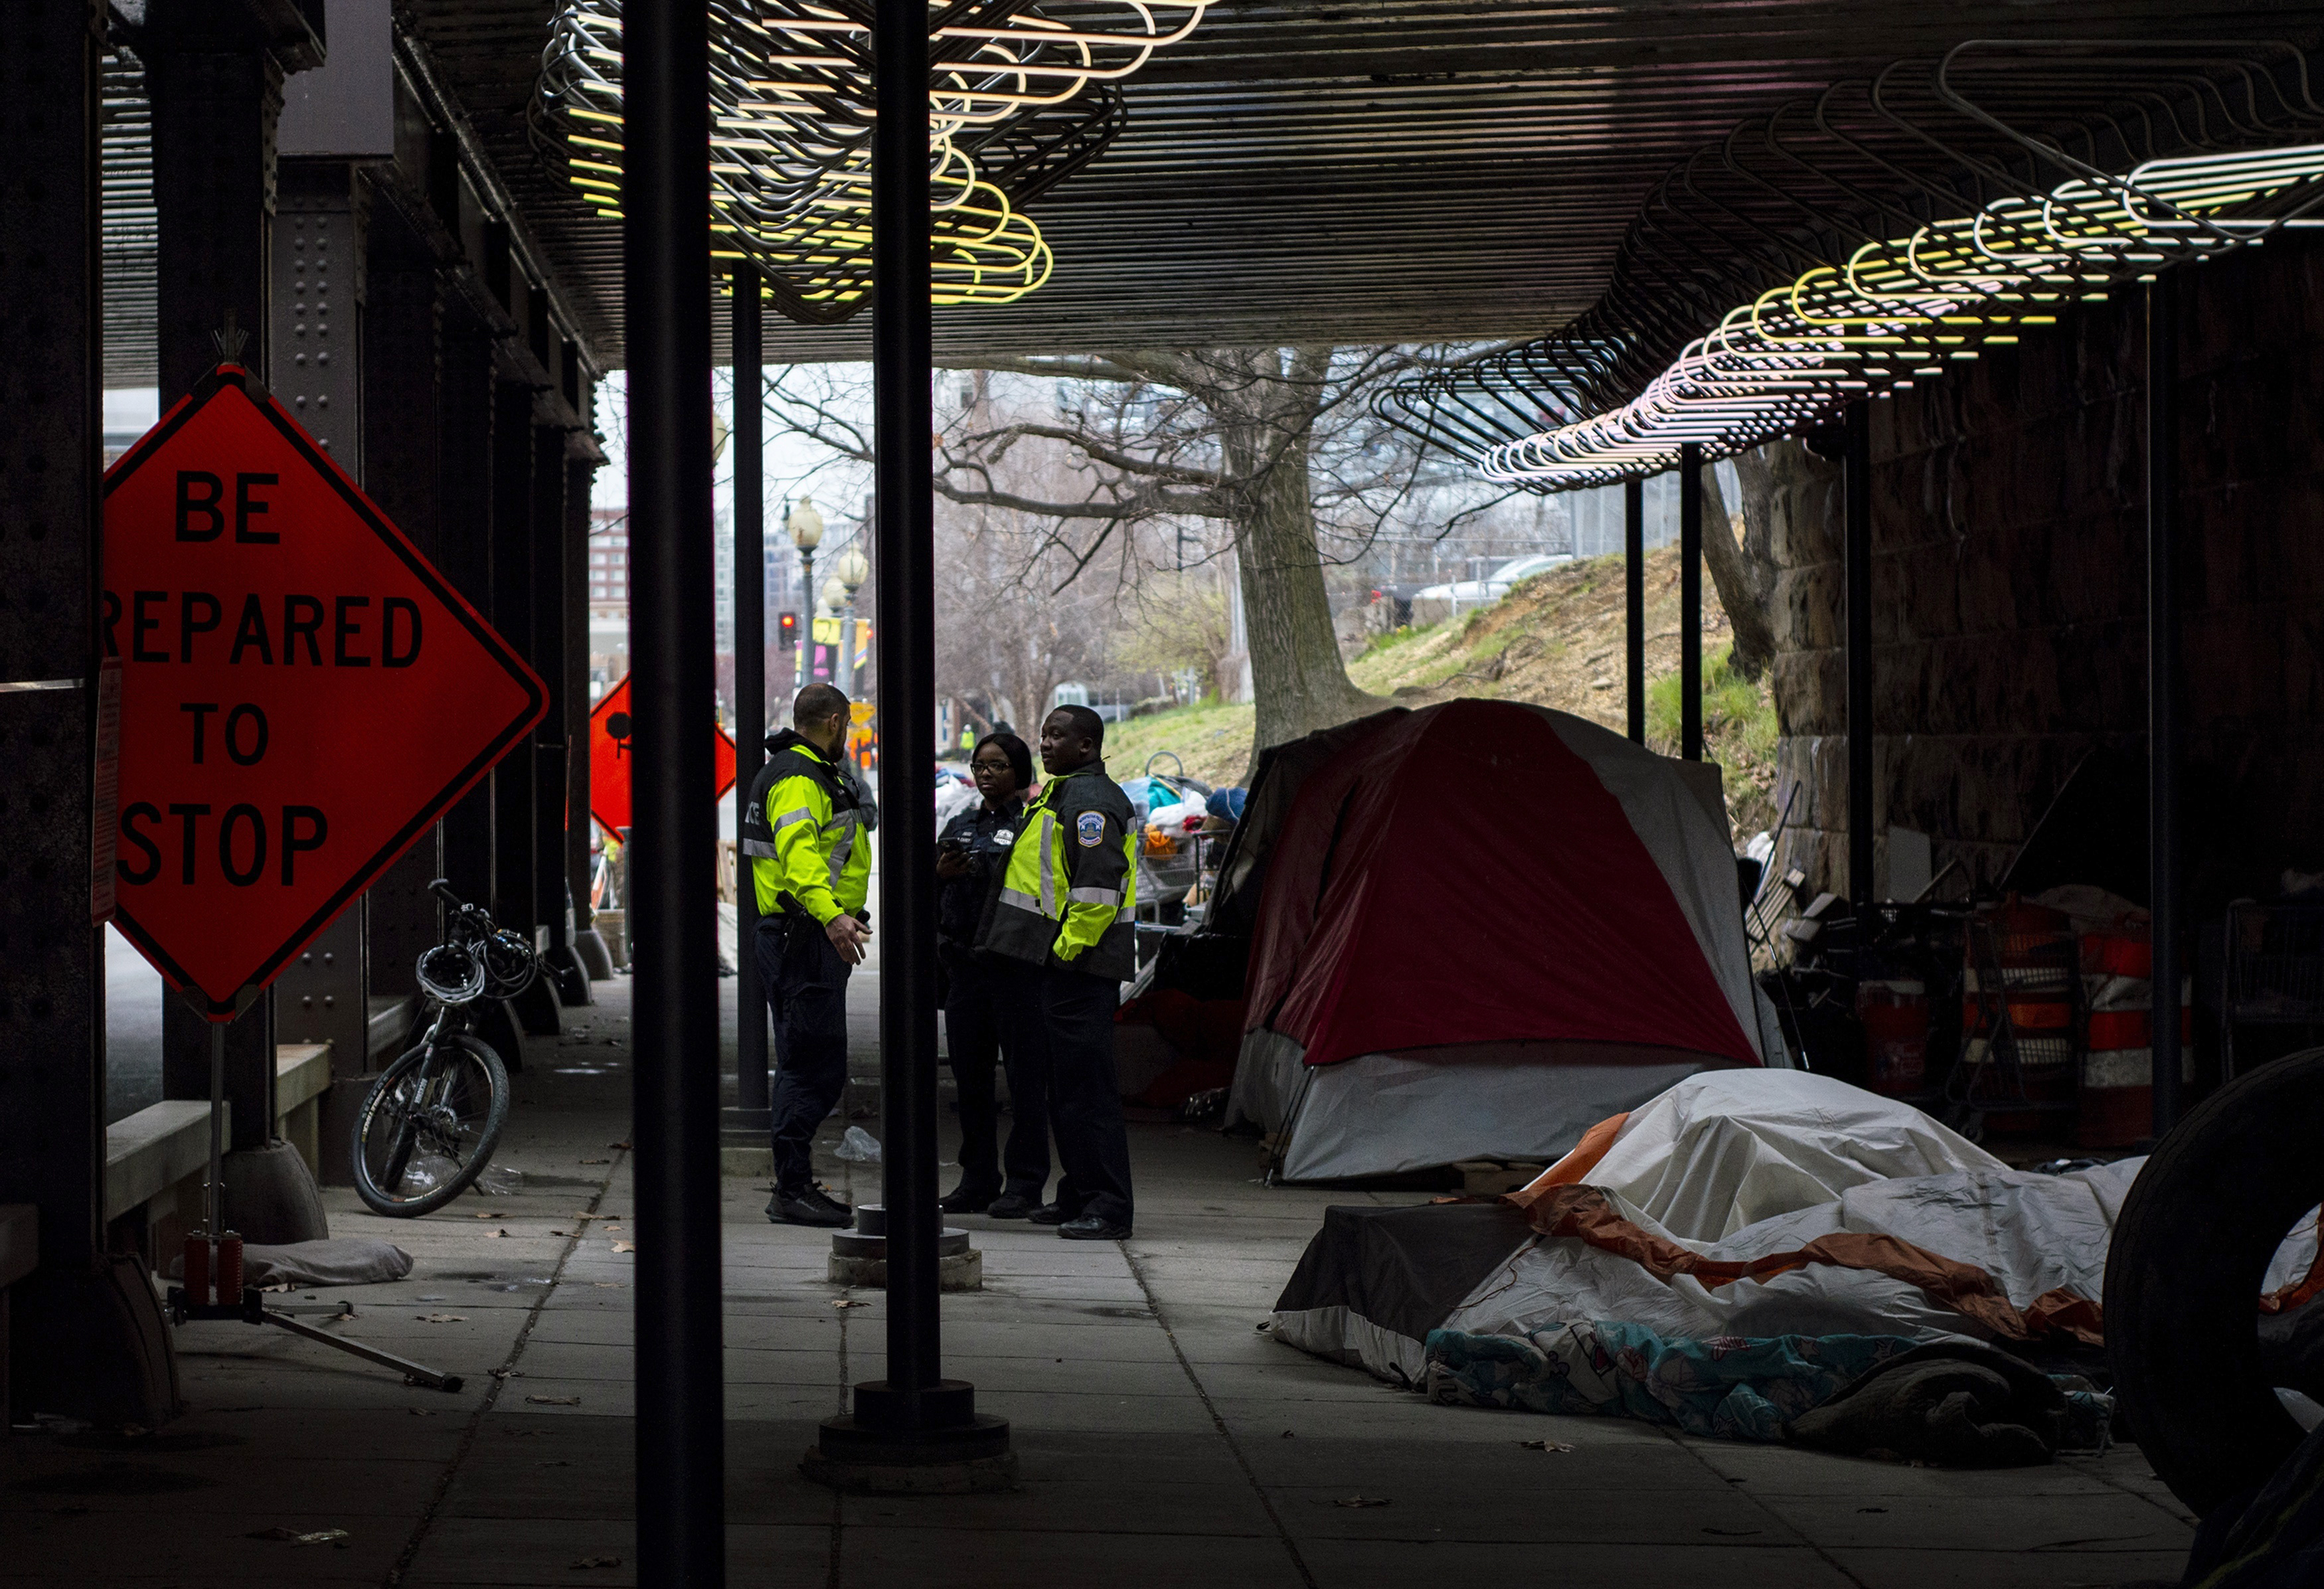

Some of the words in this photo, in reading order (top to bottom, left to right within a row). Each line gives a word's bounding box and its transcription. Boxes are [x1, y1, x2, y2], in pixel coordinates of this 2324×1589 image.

[174, 470, 280, 544] BE
[104, 590, 423, 668] REPARED
[181, 702, 270, 766] TO
[116, 801, 329, 887] STOP
